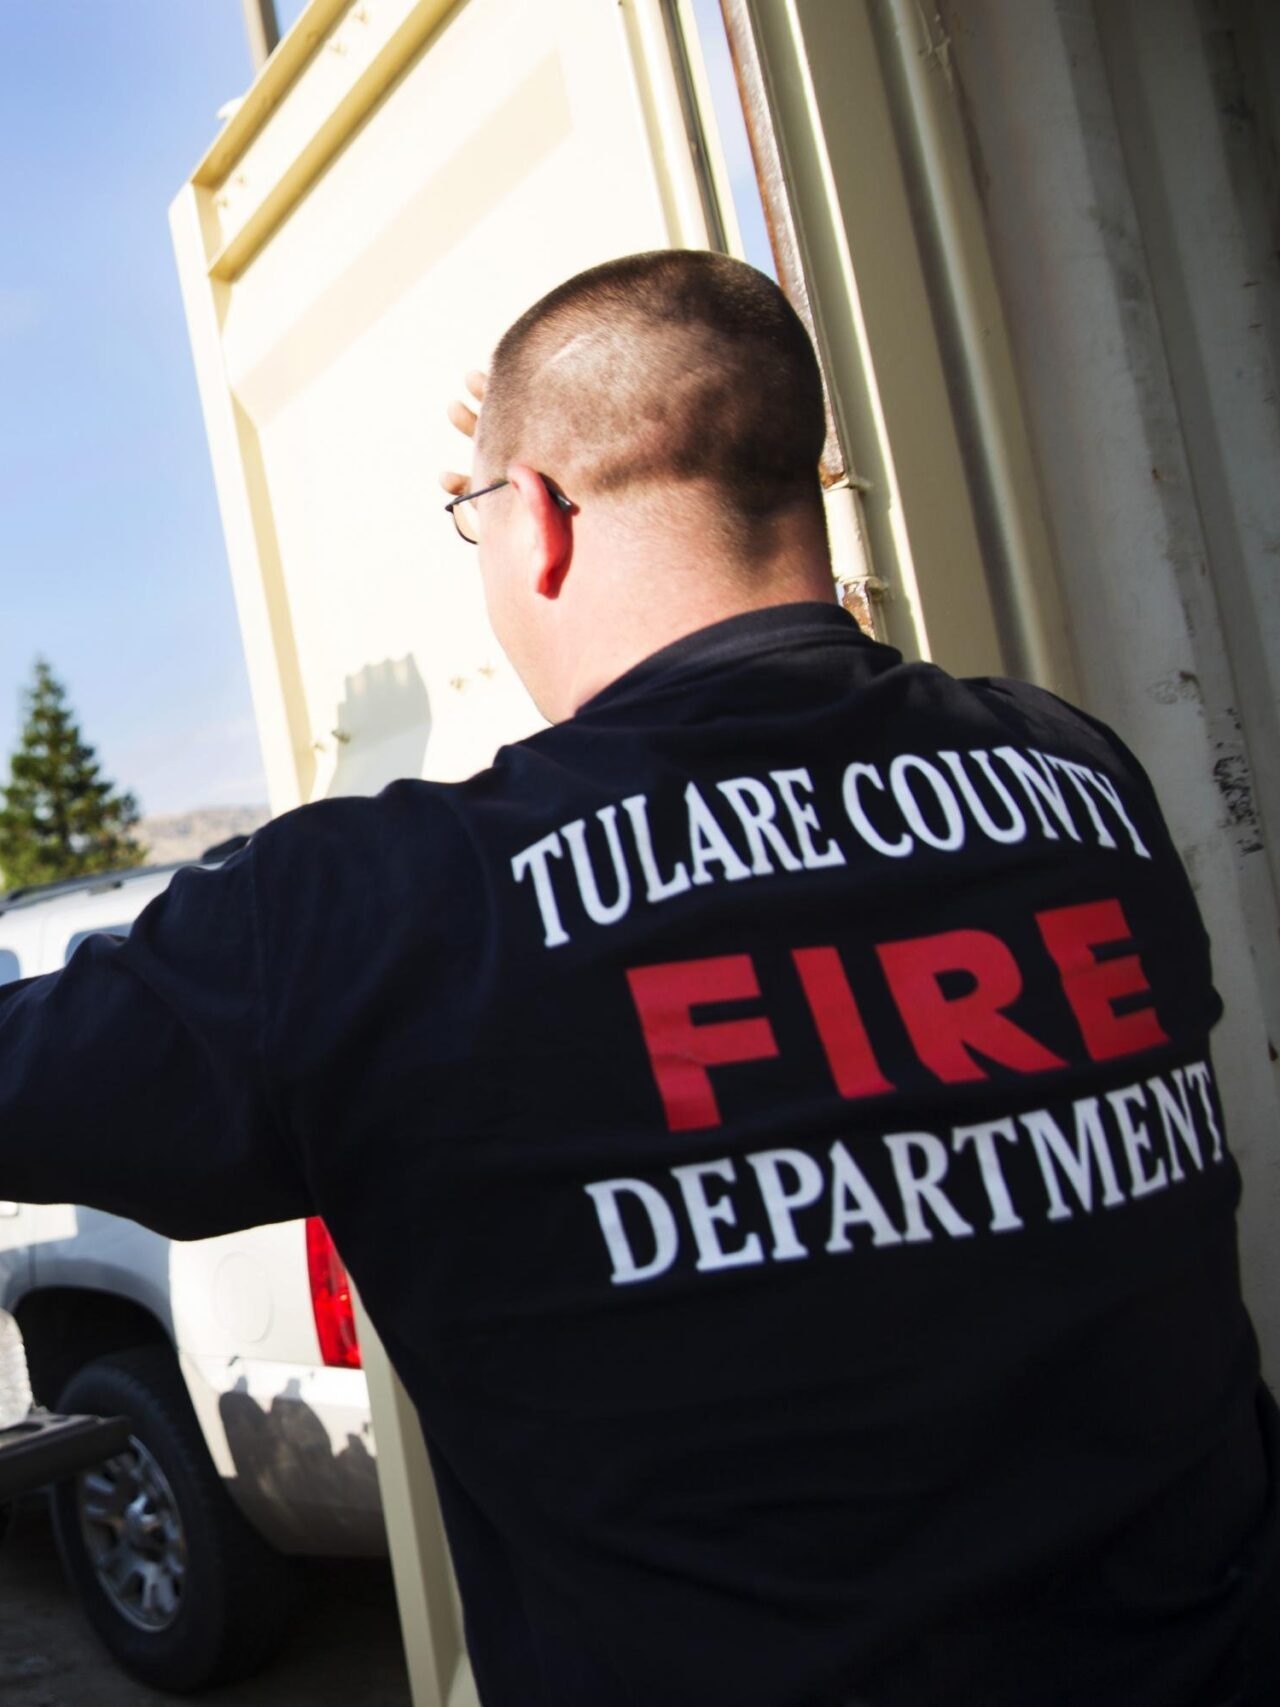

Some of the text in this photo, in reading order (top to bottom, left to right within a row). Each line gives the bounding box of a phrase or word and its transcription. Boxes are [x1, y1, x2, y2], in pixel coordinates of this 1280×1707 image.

[511, 745, 1152, 947] TULARE COUNTY
[625, 898, 1172, 1133] FIRE
[583, 1061, 1224, 1286] DEPARTMENT
